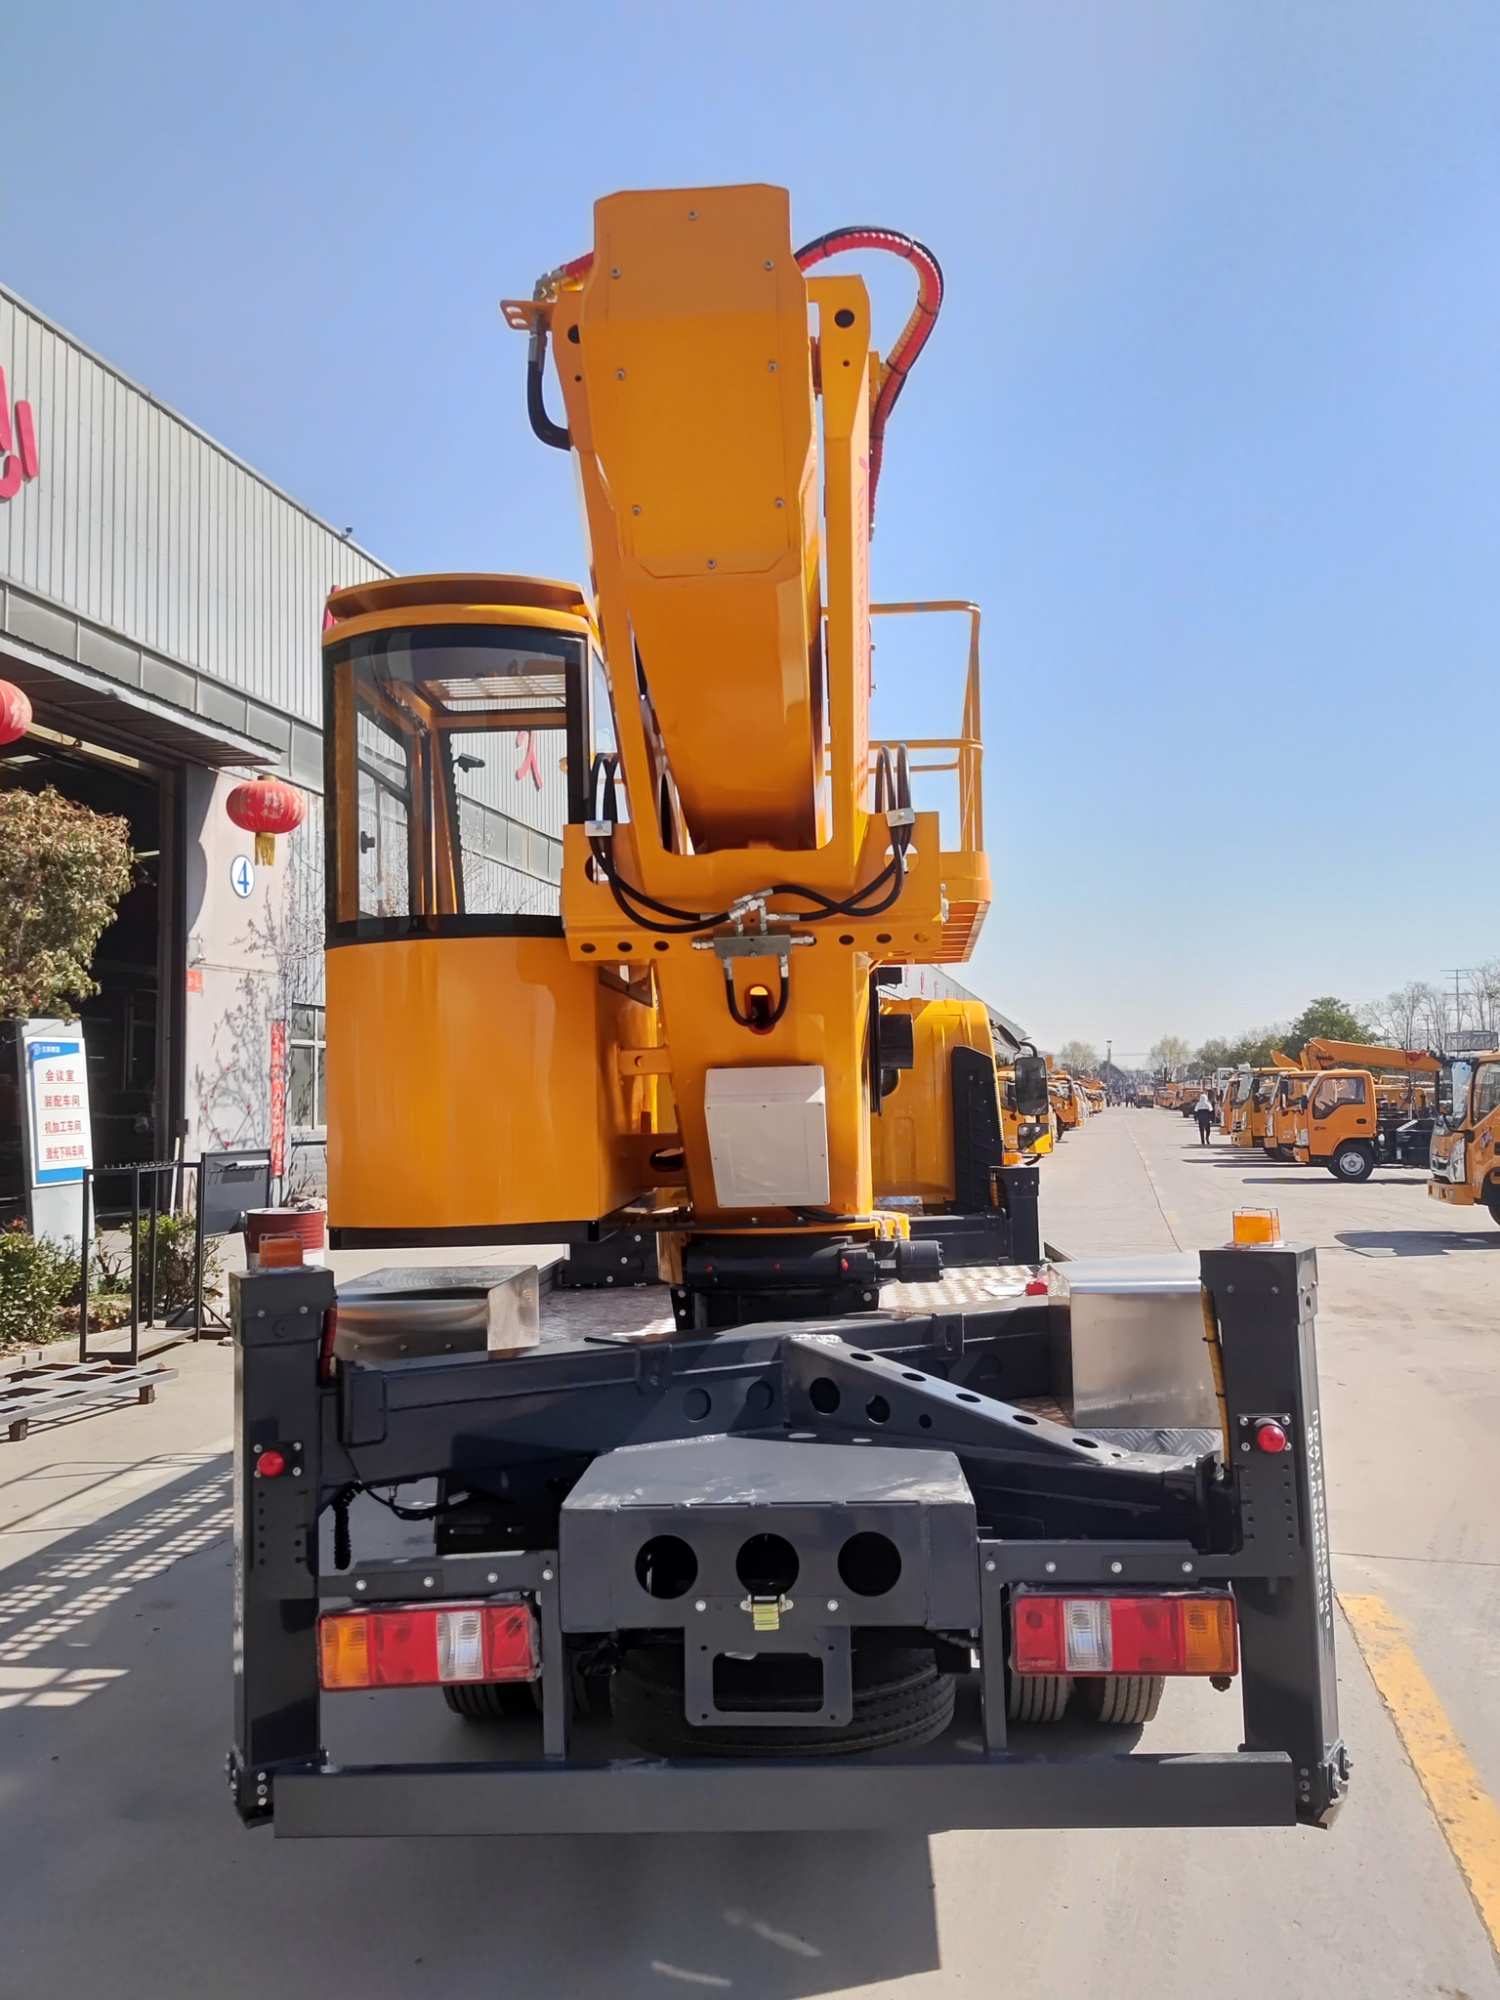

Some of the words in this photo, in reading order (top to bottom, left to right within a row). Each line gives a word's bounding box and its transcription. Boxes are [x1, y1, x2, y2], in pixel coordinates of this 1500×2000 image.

[237, 860, 250, 894] 4
[45, 1069, 75, 1082] 会议室
[44, 1094, 80, 1108] 装配车间
[44, 1120, 82, 1134] 机加工车间
[45, 1145, 85, 1160] 激光下料车间
[1312, 1409, 1331, 1630] Подтверждение
